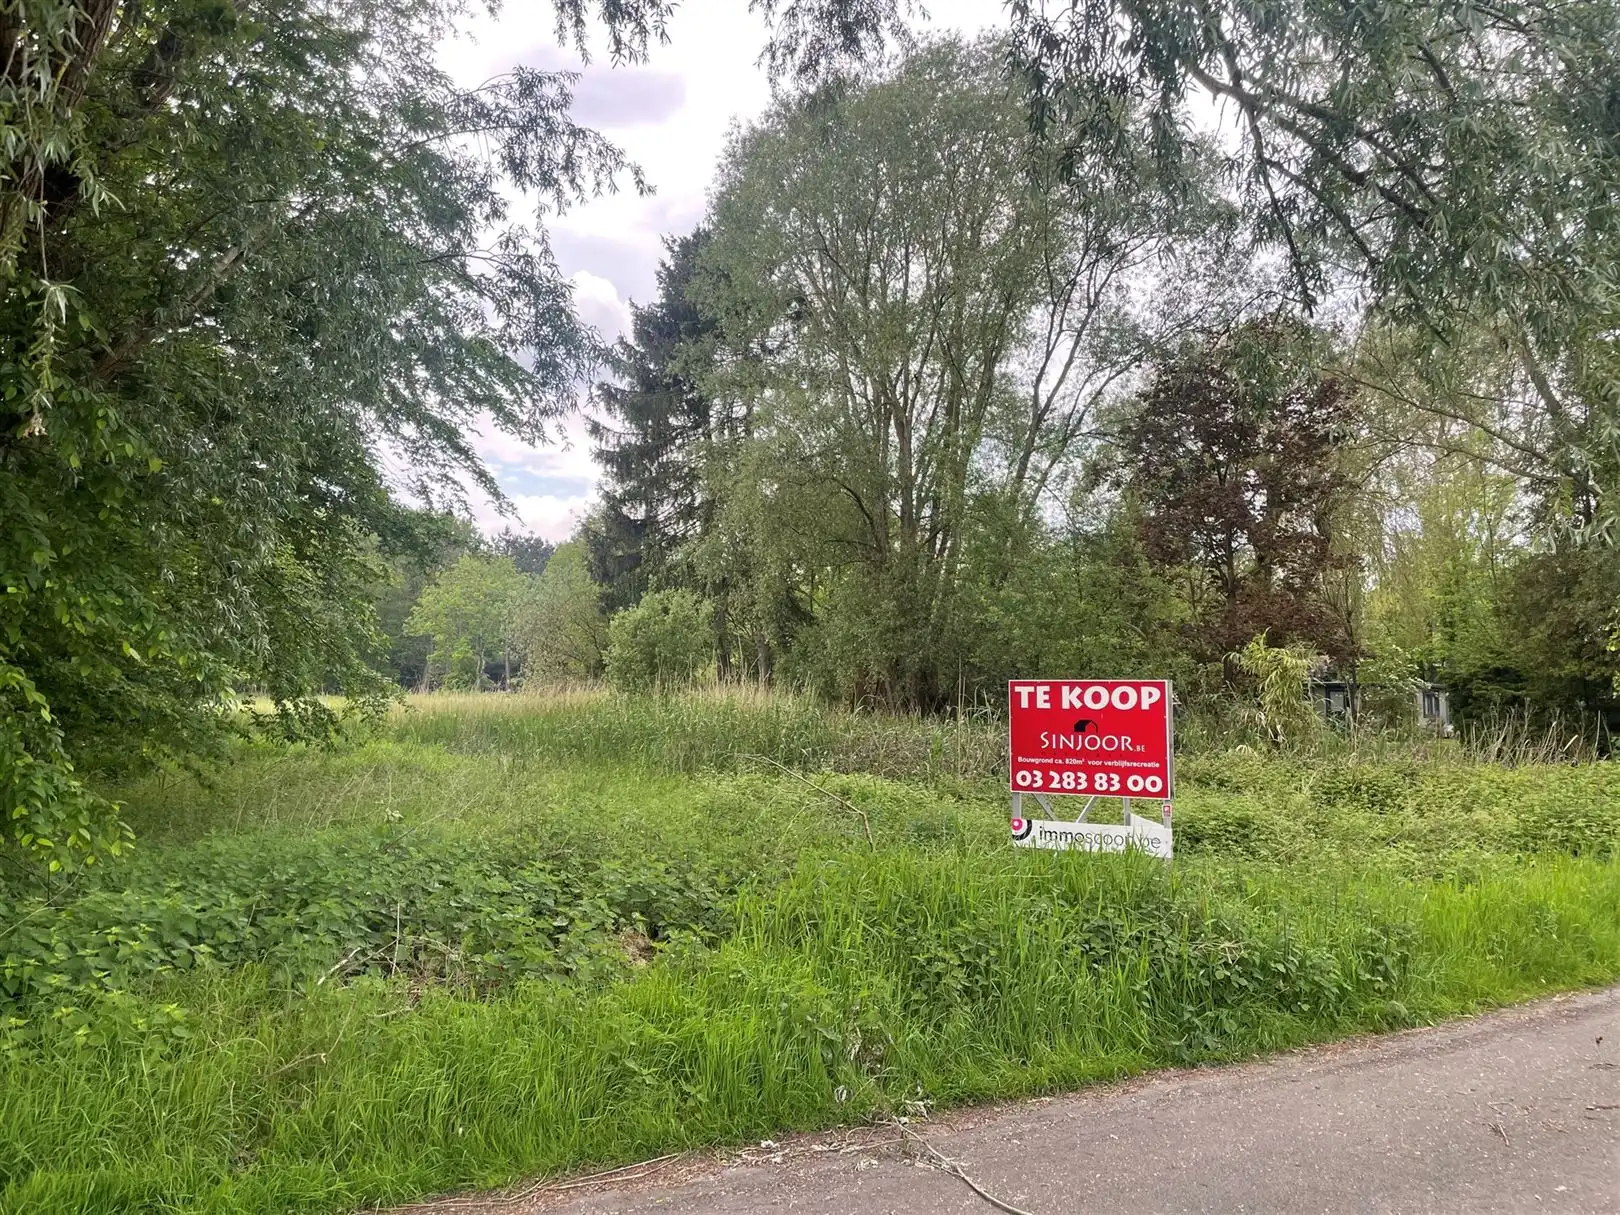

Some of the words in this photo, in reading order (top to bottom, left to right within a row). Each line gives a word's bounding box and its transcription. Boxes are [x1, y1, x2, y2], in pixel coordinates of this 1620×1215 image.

[1014, 685, 1050, 709] TE
[1061, 685, 1160, 710] KOOP
[1017, 756, 1053, 765] Bouwgrond
[1104, 760, 1160, 768] verblijfsrecreatie
[1016, 770, 1043, 788] 03
[1048, 771, 1088, 790] 283
[1094, 773, 1121, 792] 83
[1127, 775, 1163, 792] 00
